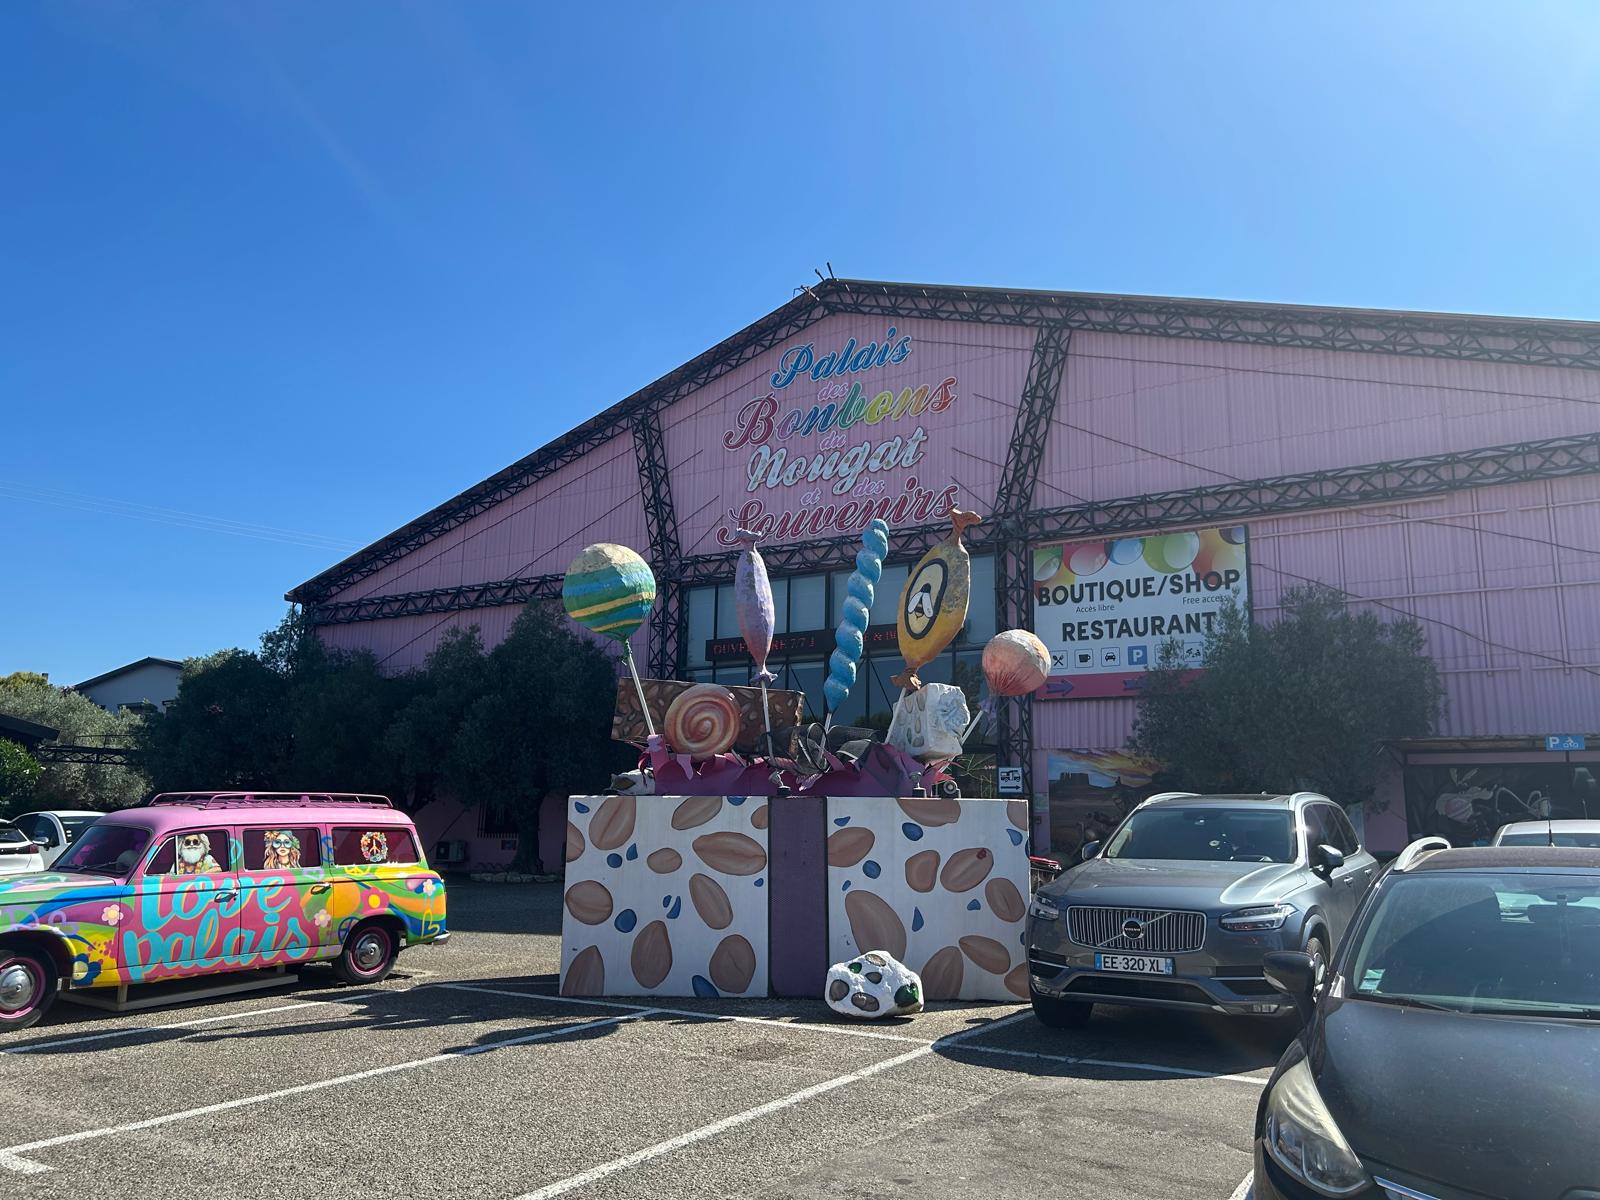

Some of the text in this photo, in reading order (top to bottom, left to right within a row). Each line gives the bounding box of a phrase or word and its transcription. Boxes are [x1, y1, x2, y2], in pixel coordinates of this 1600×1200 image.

[770, 327, 912, 389] Palais
[817, 382, 848, 401] des
[723, 377, 958, 451] Bonbons
[819, 431, 847, 451] du
[747, 426, 928, 495] Nougat
[801, 477, 885, 506] et des
[716, 475, 960, 546] Souvenirs
[1038, 569, 1240, 606] BOUTIQUE/SHOP
[1182, 596, 1200, 605] Free
[1062, 612, 1217, 642] RESTAURANT
